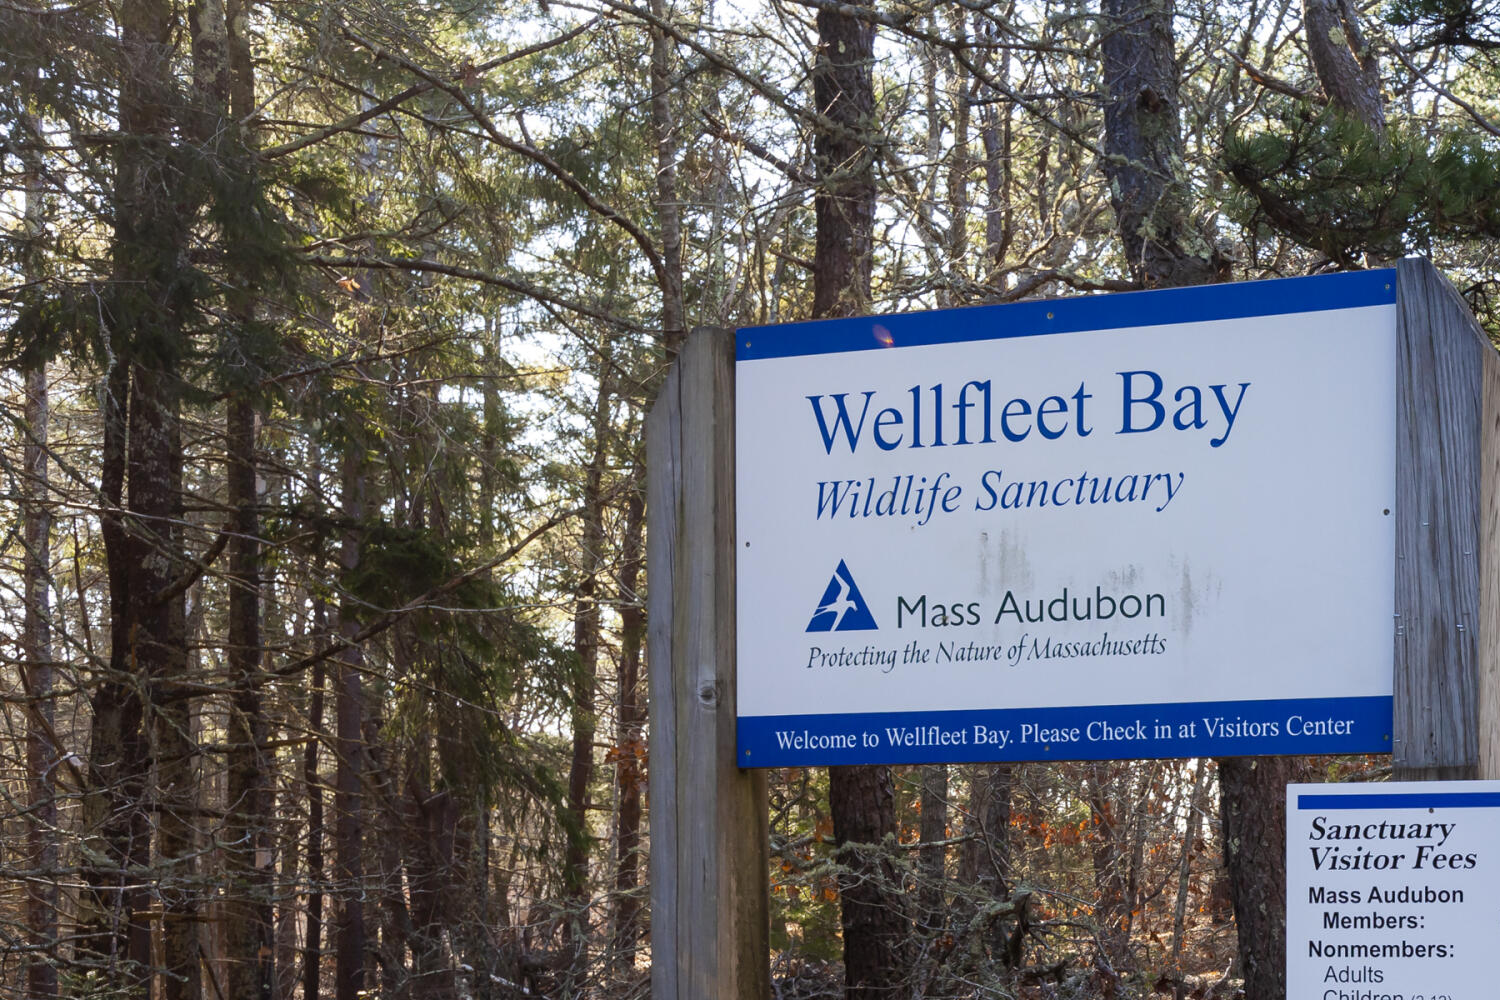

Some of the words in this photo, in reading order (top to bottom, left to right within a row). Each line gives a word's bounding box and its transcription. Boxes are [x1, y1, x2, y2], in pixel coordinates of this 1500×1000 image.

[805, 379, 1093, 455] Wellfleet
[1115, 371, 1251, 448] Bay
[817, 472, 962, 526] Wildlife
[975, 470, 1184, 512] Sanctuary
[898, 595, 980, 629] Mass
[994, 586, 1165, 624] Audubon
[807, 646, 897, 674] Protecting
[903, 640, 930, 664] the
[935, 641, 1002, 664] Nature
[1007, 633, 1028, 667] of
[1027, 632, 1167, 661] Massachusetts
[776, 730, 856, 749] Welcome
[862, 731, 879, 747] to
[885, 726, 967, 746] Wellfleet
[974, 725, 1013, 749] Bay.
[1021, 723, 1080, 743] Please
[1087, 720, 1147, 741] Check
[1154, 719, 1172, 739] in
[1179, 721, 1196, 738] at
[1203, 717, 1279, 738] Visitors
[1286, 715, 1354, 736] Center
[1309, 816, 1456, 847] Sanctuary
[1310, 846, 1405, 870] Visitor
[1412, 845, 1477, 869] Fees
[1309, 887, 1361, 904] Mass
[1367, 886, 1463, 903] Audubon
[1324, 911, 1424, 929] Members:
[1309, 940, 1454, 958] Nonmembers:
[1324, 965, 1384, 983] Adults
